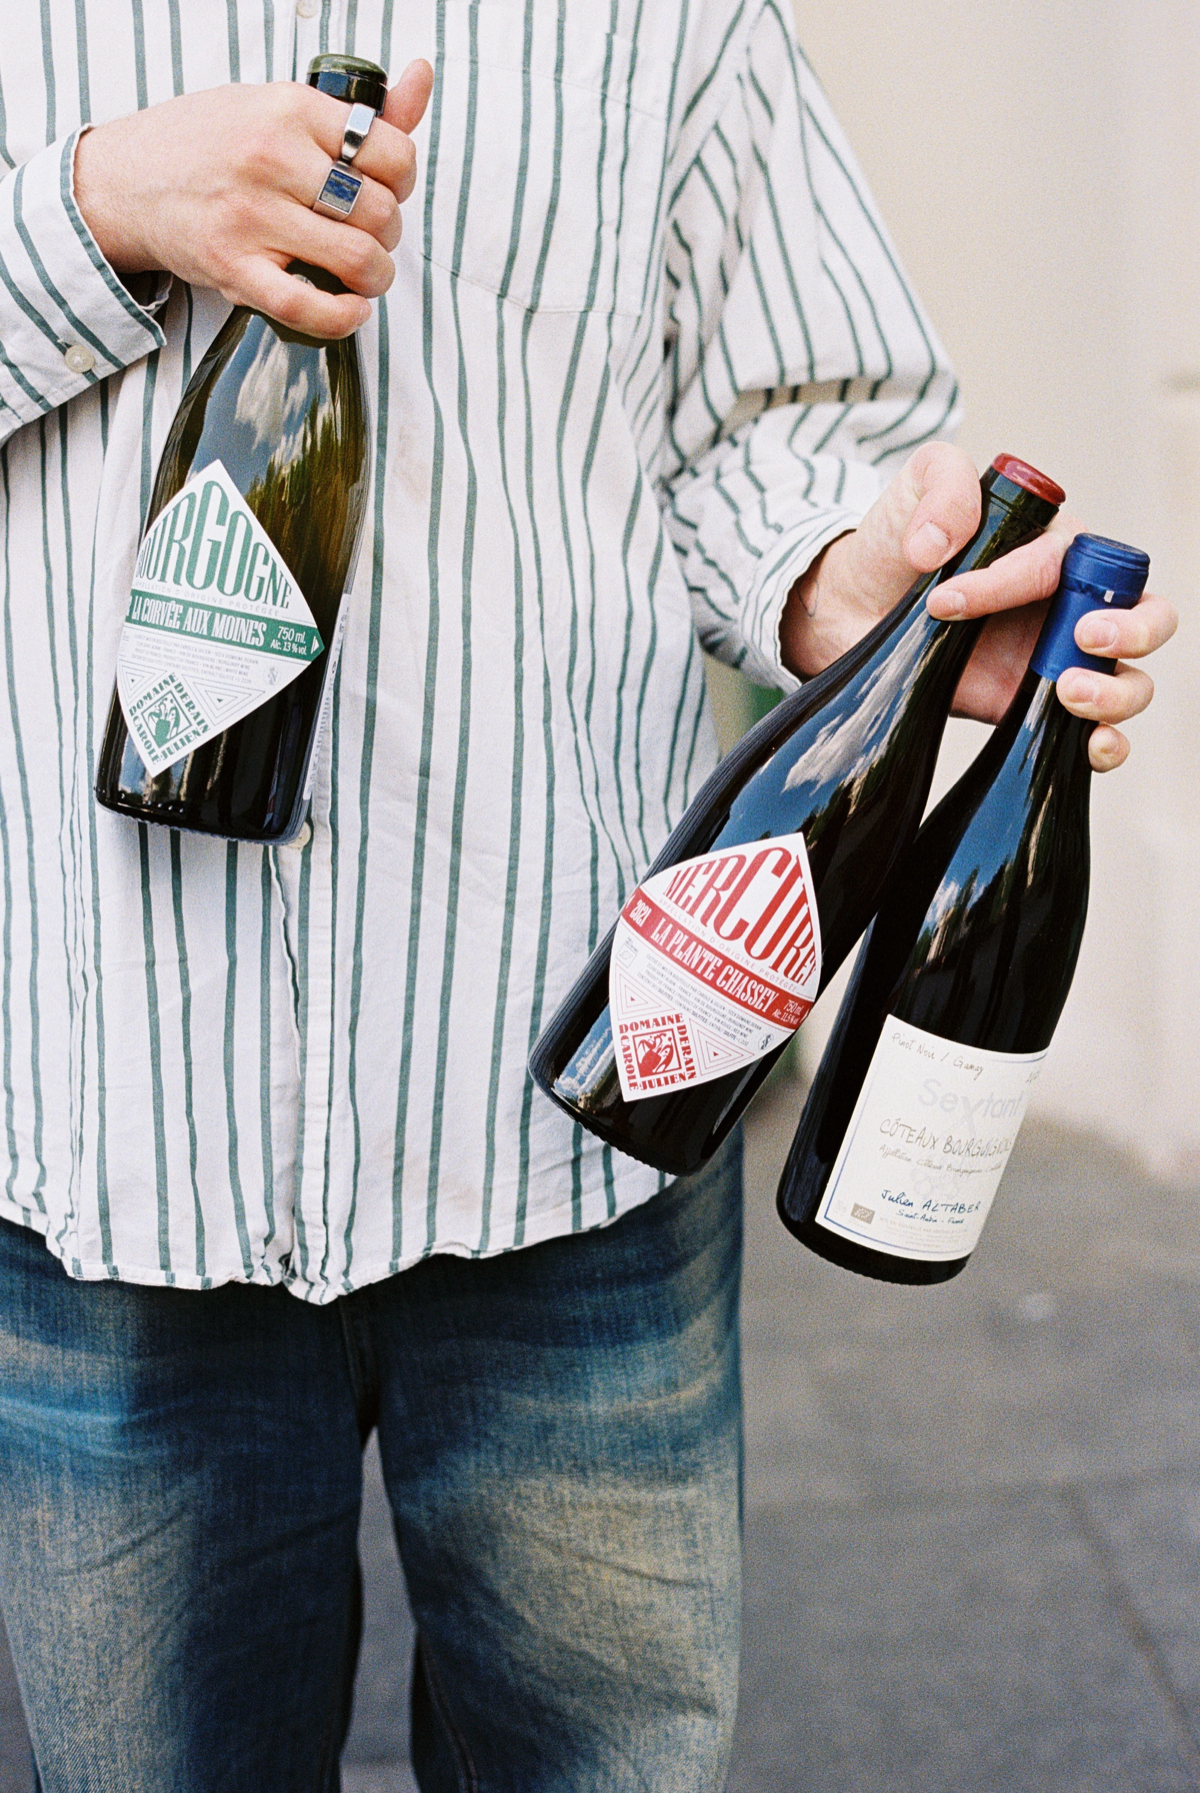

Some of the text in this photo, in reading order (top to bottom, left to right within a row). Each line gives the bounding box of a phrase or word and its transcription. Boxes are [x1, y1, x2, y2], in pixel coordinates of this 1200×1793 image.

[136, 480, 292, 609] BOURGOGNE
[141, 597, 184, 630] CORVÉE
[182, 607, 212, 636] AUX
[211, 612, 267, 647] MOINES
[228, 600, 280, 617] PROTÉGÉE
[277, 625, 295, 641] 750
[128, 672, 178, 717] DOMAINE
[174, 682, 211, 734] DERAIN
[132, 715, 162, 766] CAROLE
[159, 727, 201, 761] JULIEN
[655, 899, 707, 937] APPELLATION
[709, 936, 756, 969] D'ORIGINE
[663, 847, 817, 986] MERCUREY
[629, 899, 652, 928] 2021
[650, 917, 673, 947] LA
[665, 929, 723, 981] PLANTE
[716, 964, 780, 1013] CHASSEY
[619, 1013, 684, 1034] DOMAINE
[620, 1035, 638, 1091] CAROLE
[677, 1024, 696, 1080] DERAIN
[891, 1033, 915, 1050] Pinot
[917, 1044, 935, 1059] Noir
[953, 1056, 984, 1081] Gamay
[639, 1072, 686, 1090] JULIEN
[918, 1078, 1026, 1125] Sextant
[879, 1117, 939, 1150] CÔTEAUX
[881, 1189, 981, 1214] Julien ALTABER
